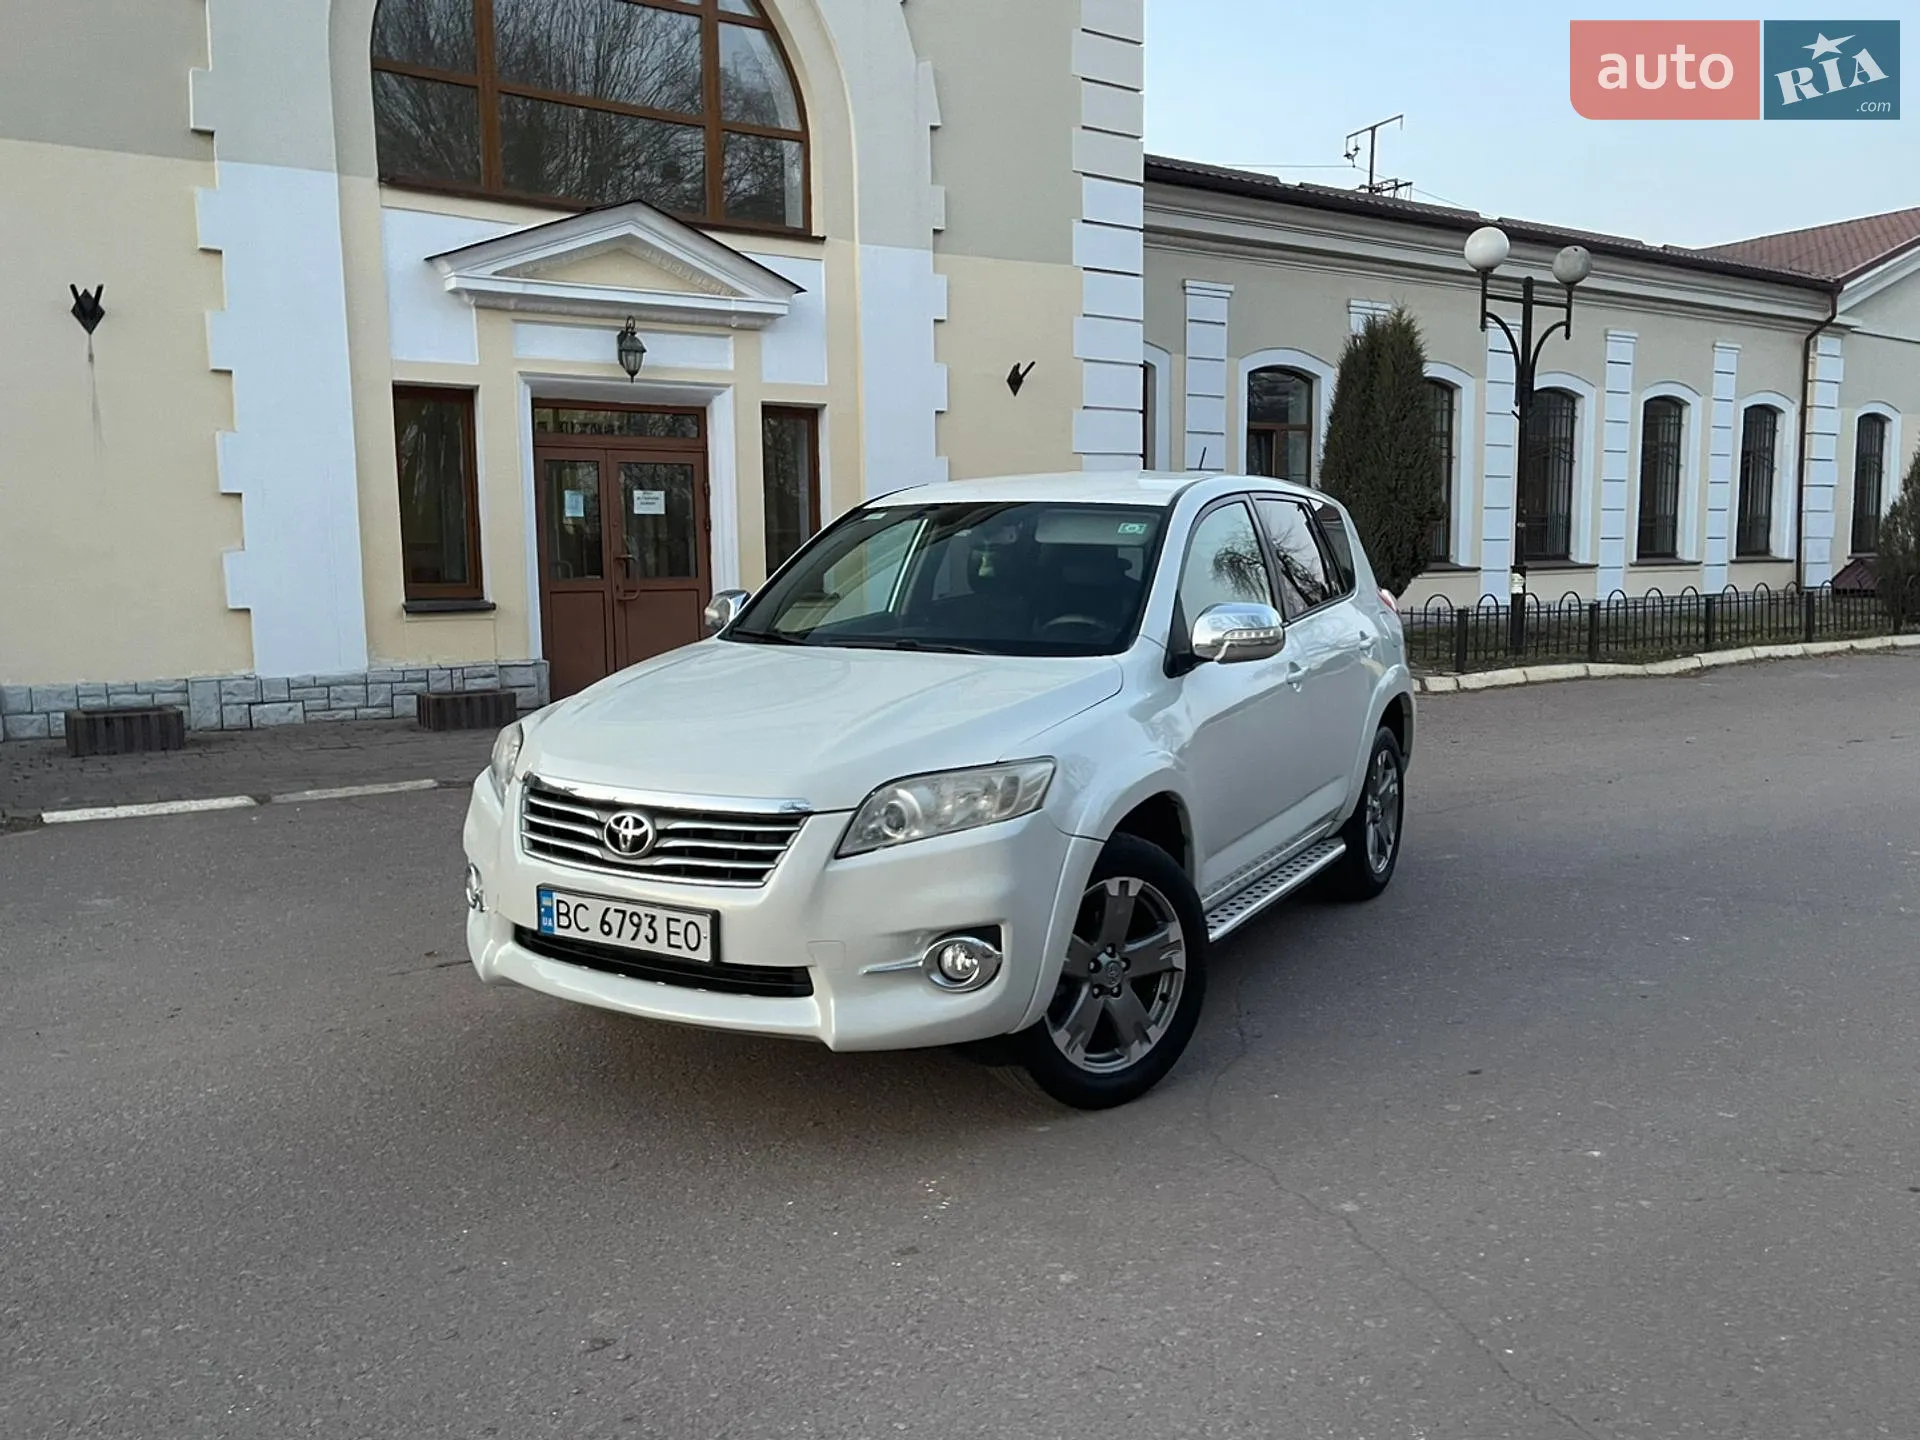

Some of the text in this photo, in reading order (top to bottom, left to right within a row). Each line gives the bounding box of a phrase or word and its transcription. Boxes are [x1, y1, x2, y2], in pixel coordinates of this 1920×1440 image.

[542, 916, 553, 926] UA
[556, 899, 701, 952] BC 6793 EO
